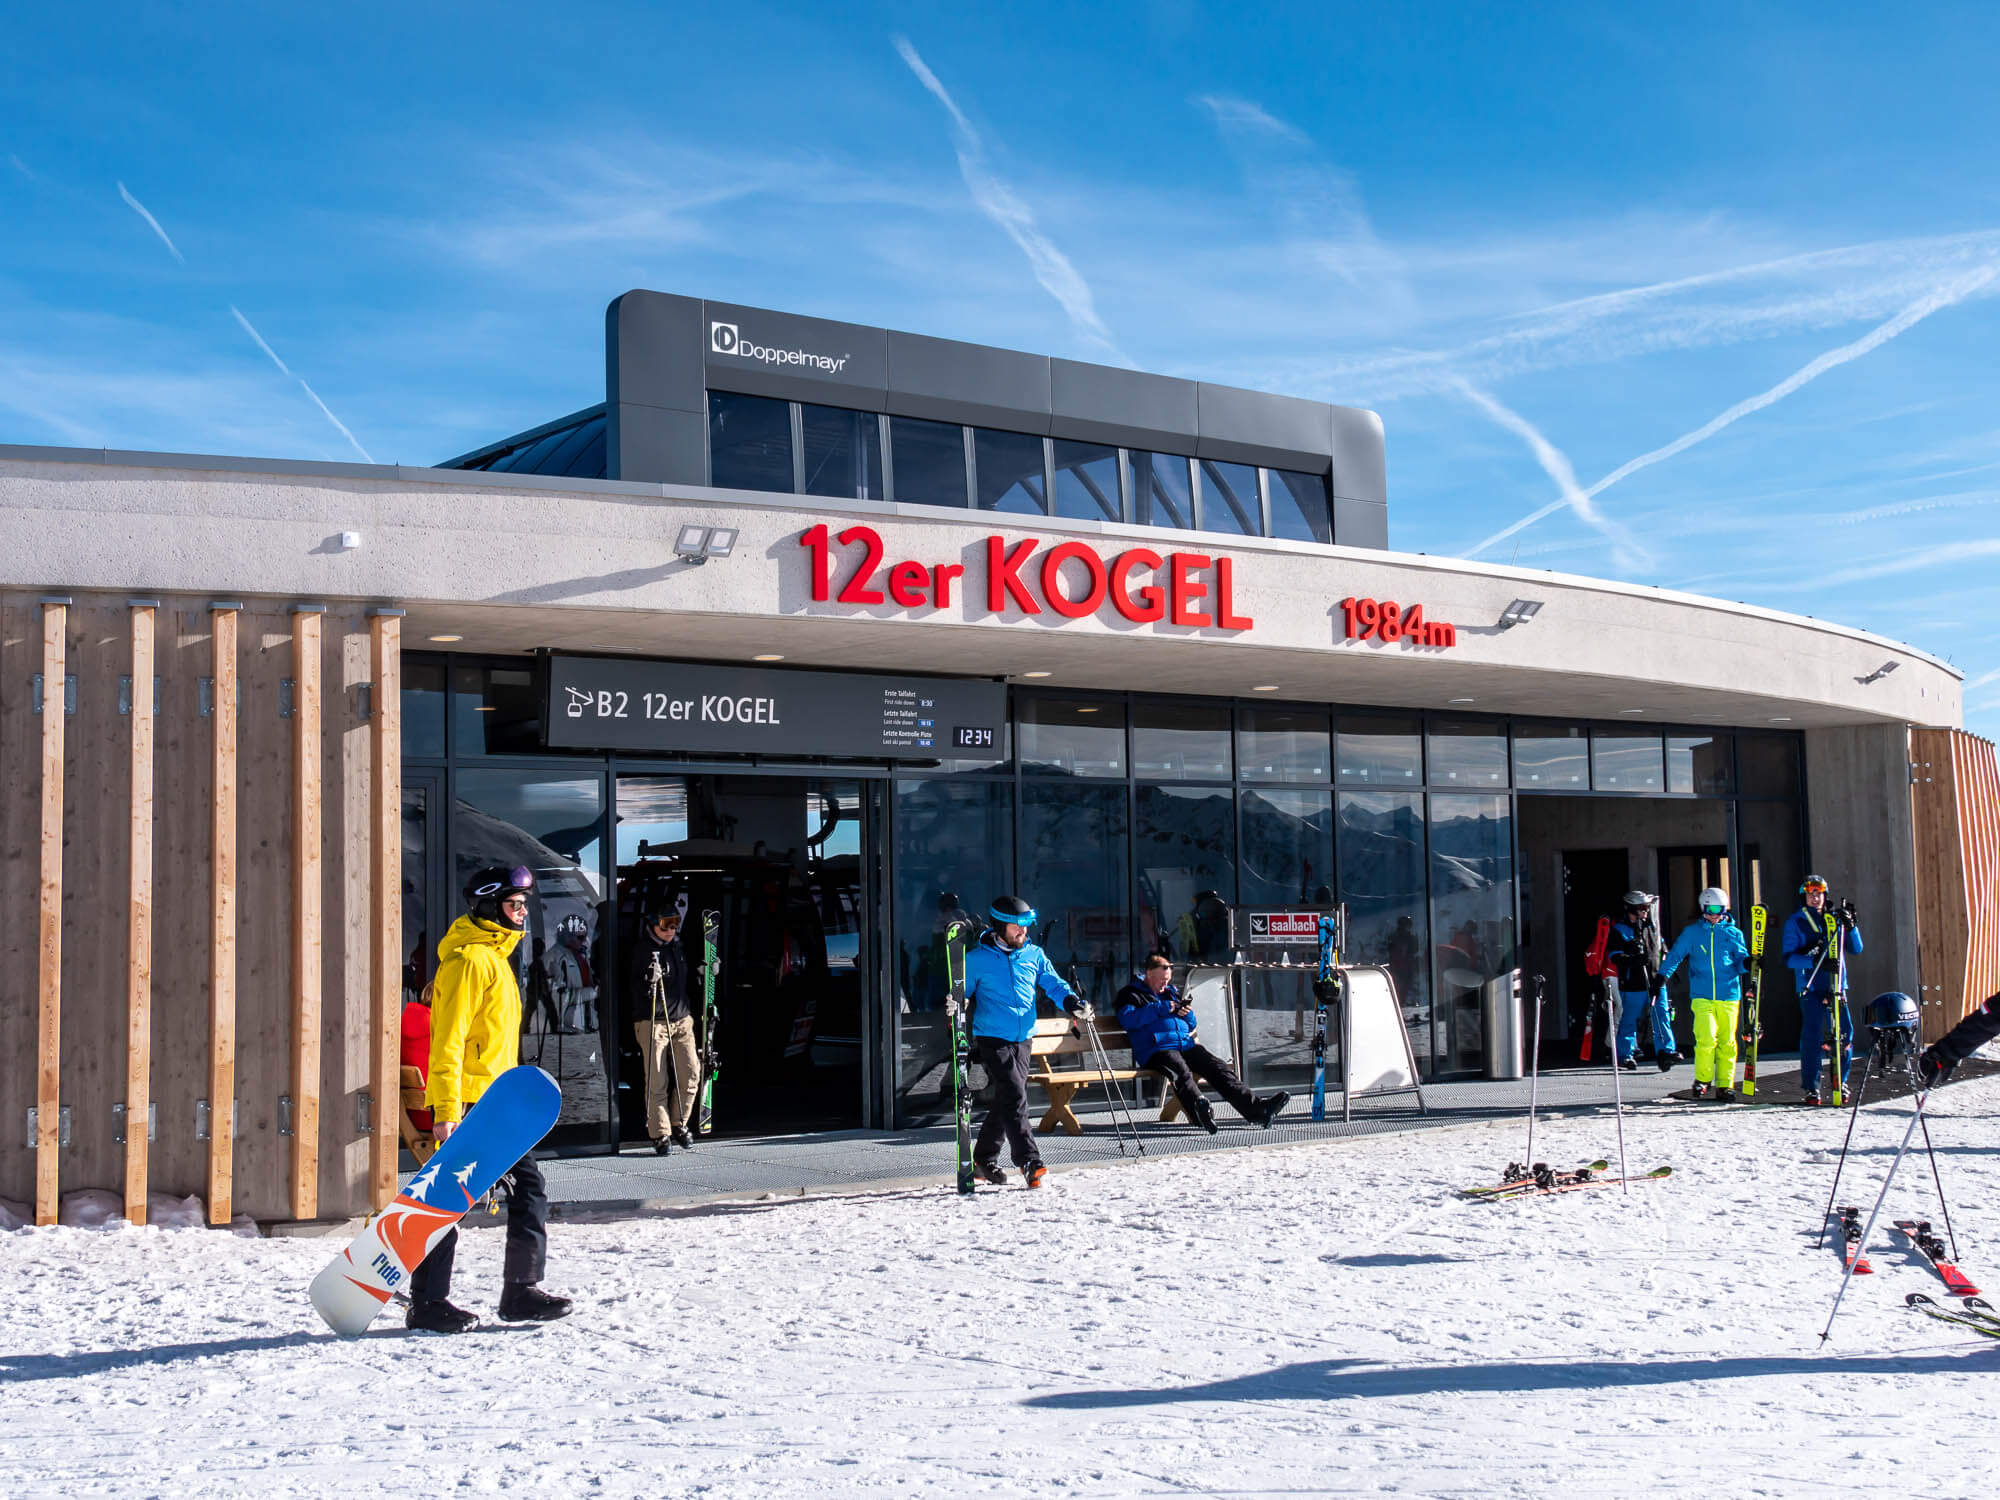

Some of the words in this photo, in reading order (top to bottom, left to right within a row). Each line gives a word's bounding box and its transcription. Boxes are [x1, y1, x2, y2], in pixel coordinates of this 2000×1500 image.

[740, 340, 846, 373] Doppelmayr
[800, 524, 964, 609] 12er
[987, 535, 1253, 631] KOGEL
[1340, 596, 1456, 647] 1984m
[597, 690, 629, 718] B2
[643, 692, 694, 721] 12er
[701, 695, 780, 724] KOGEL
[1271, 914, 1316, 932] saalbach
